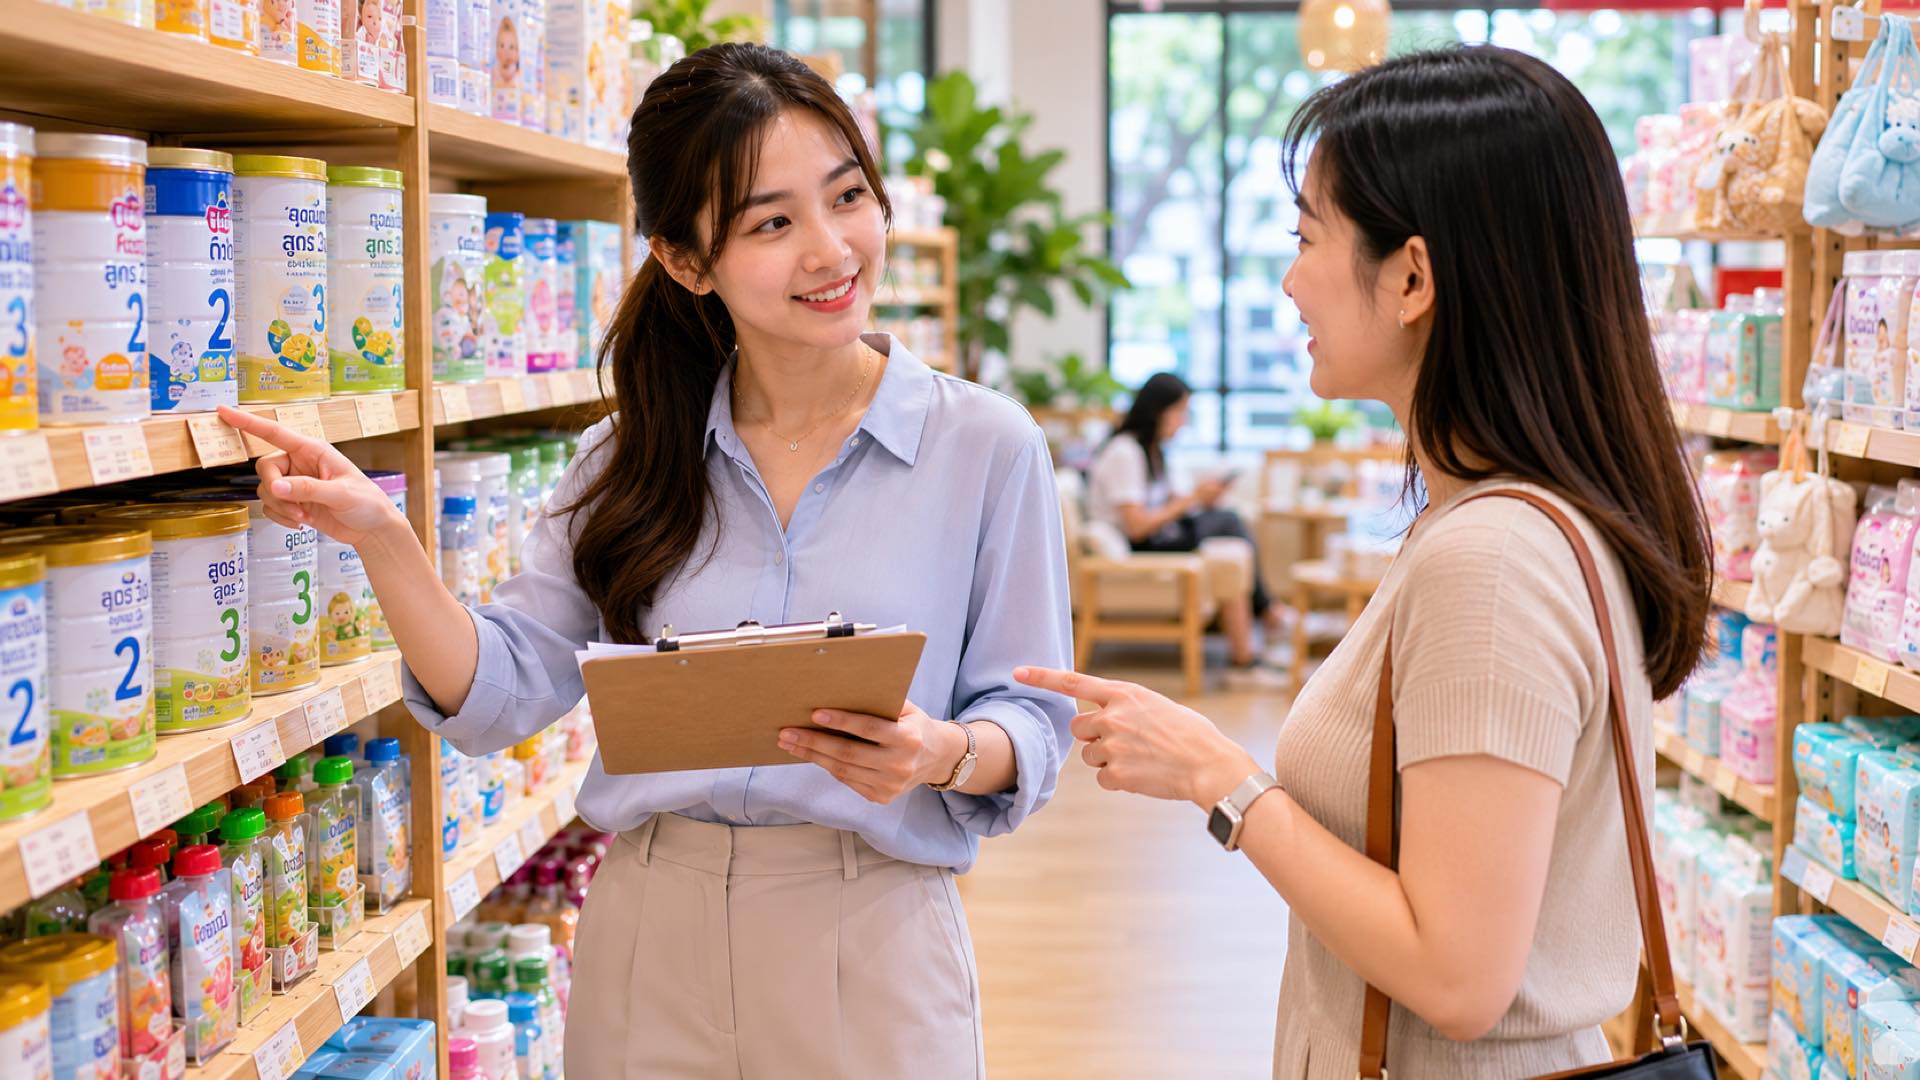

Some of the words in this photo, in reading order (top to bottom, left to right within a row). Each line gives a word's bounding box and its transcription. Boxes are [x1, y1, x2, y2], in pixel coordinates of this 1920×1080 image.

[7, 295, 27, 358] 3
[127, 292, 146, 352] 2
[208, 288, 231, 350] 2
[312, 283, 325, 333] 3
[292, 569, 312, 625] 3
[220, 607, 241, 663] 3
[114, 635, 143, 701] 2
[8, 677, 37, 747] 2
